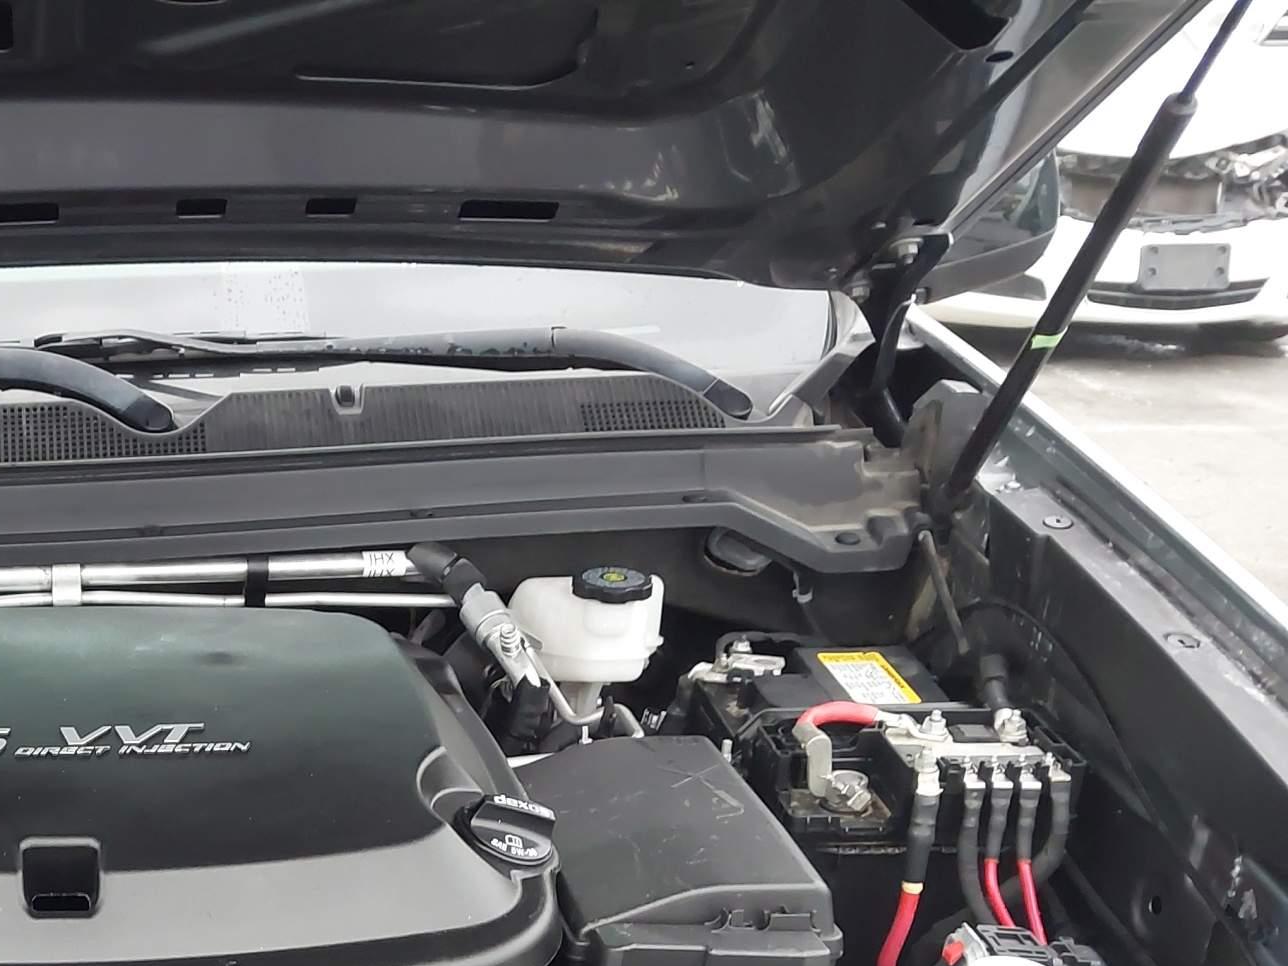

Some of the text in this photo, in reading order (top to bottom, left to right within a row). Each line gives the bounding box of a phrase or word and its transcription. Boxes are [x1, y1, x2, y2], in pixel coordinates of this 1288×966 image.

[60, 722, 204, 745] VVT
[14, 741, 251, 758] DIRECT INJECTION
